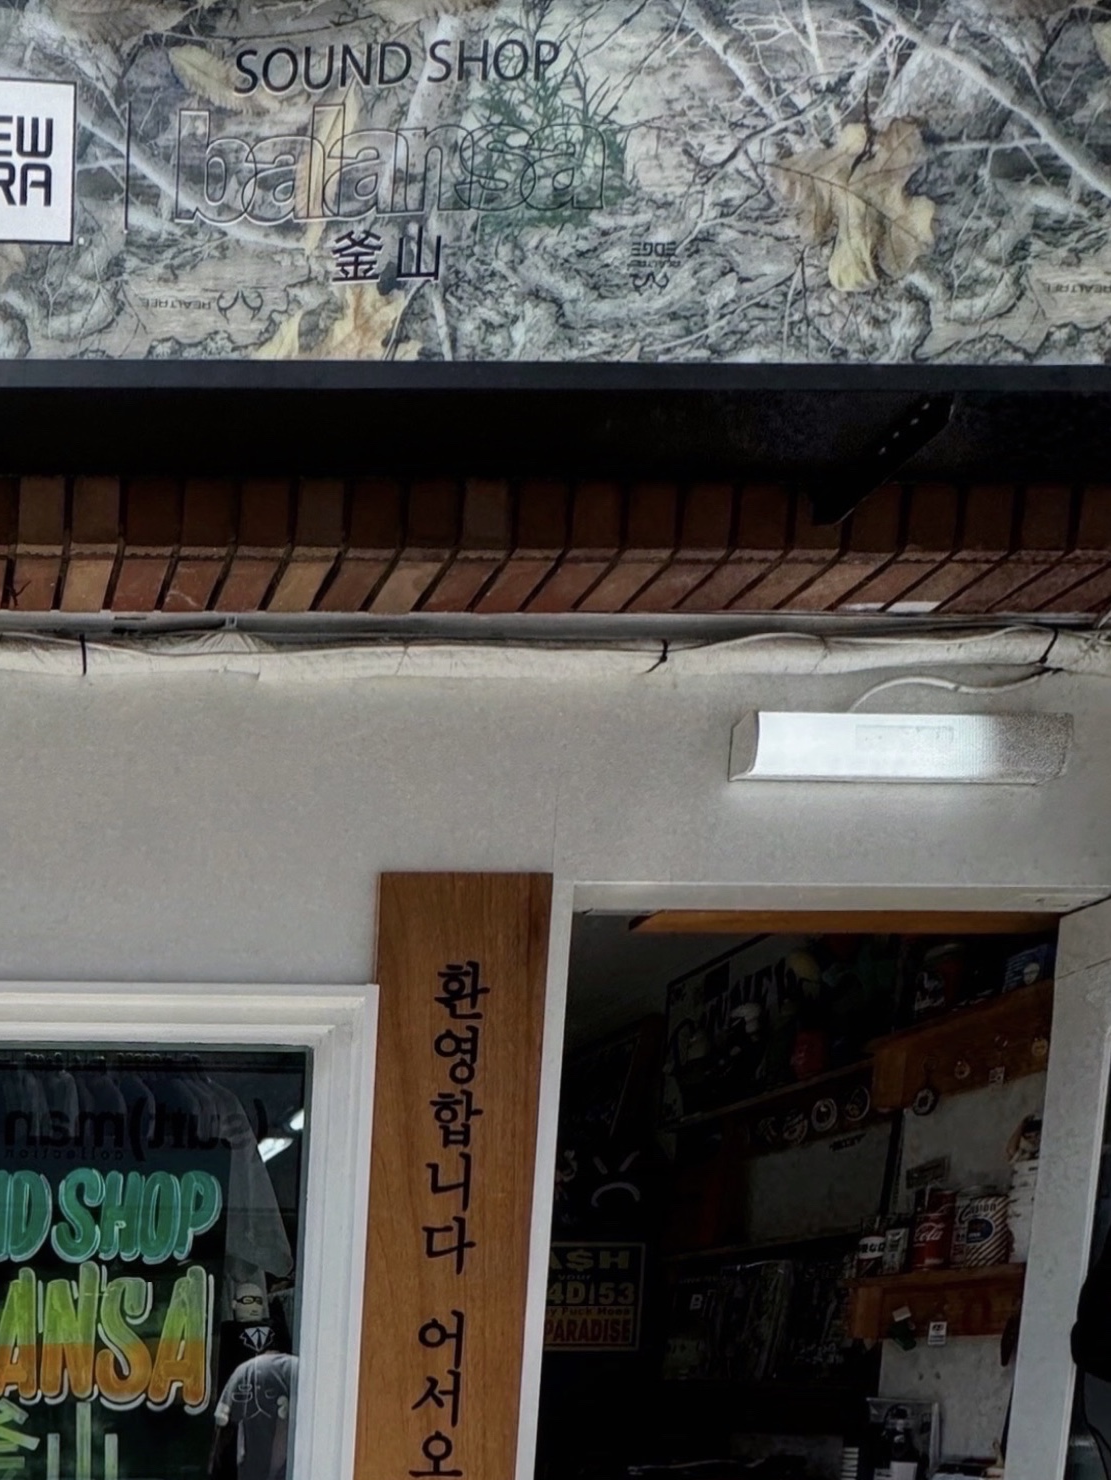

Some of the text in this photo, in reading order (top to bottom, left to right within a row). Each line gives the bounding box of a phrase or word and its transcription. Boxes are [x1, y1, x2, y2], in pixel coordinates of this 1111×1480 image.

[233, 38, 558, 95] SOUND SHOP
[174, 103, 607, 222] balansa
[331, 226, 442, 282] 釜山
[421, 960, 491, 1275] 환영합니다
[52, 1167, 222, 1265] SHOP
